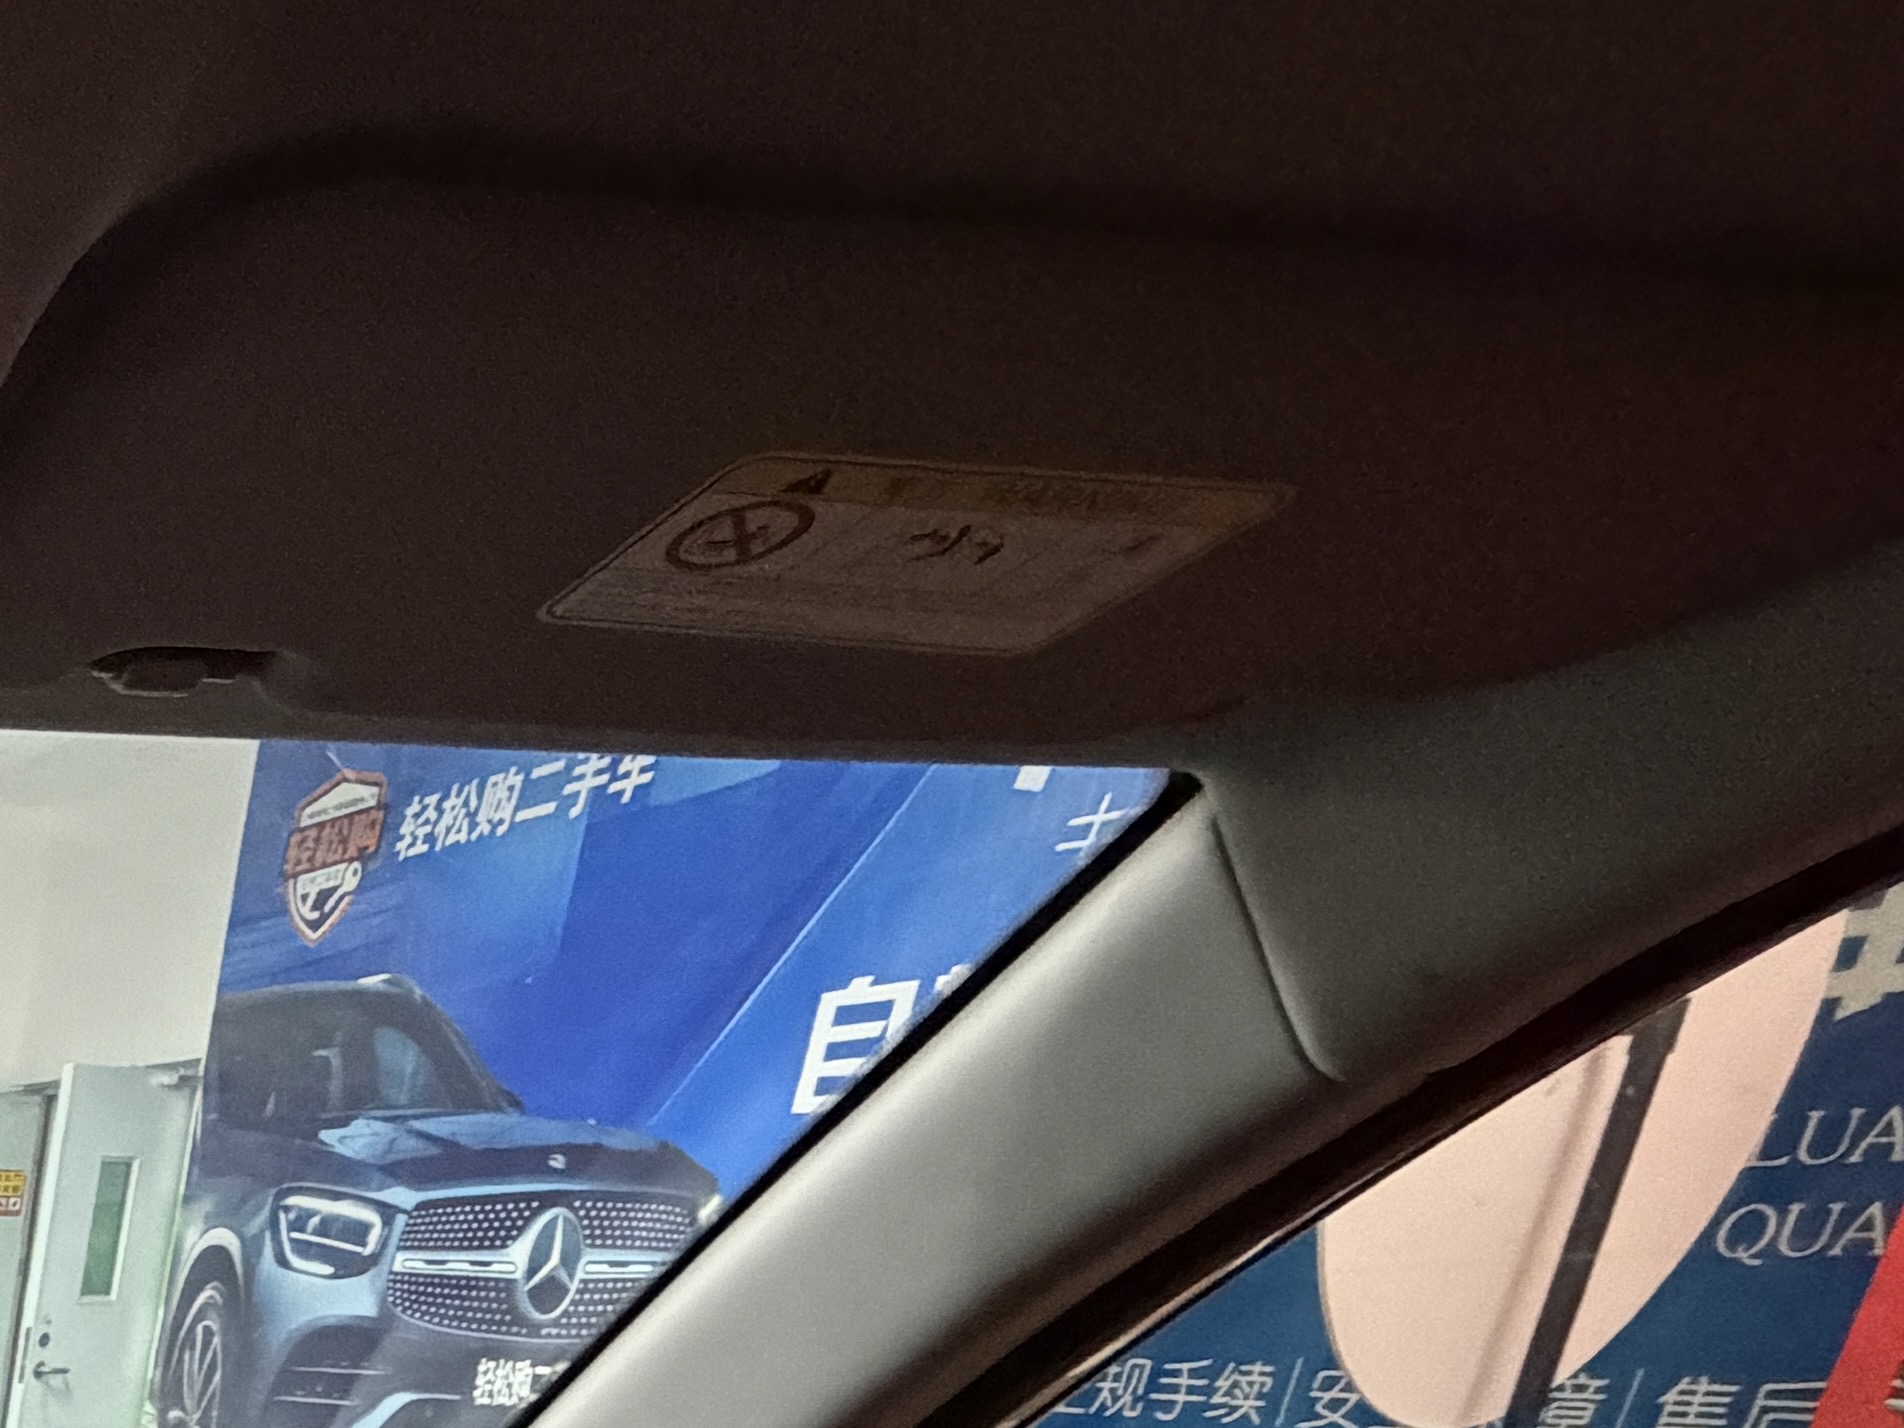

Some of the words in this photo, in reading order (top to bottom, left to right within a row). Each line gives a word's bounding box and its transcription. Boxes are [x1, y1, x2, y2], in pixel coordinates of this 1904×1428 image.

[396, 755, 657, 861] 轻松购二手车
[1050, 1356, 1278, 1418] 规手续
